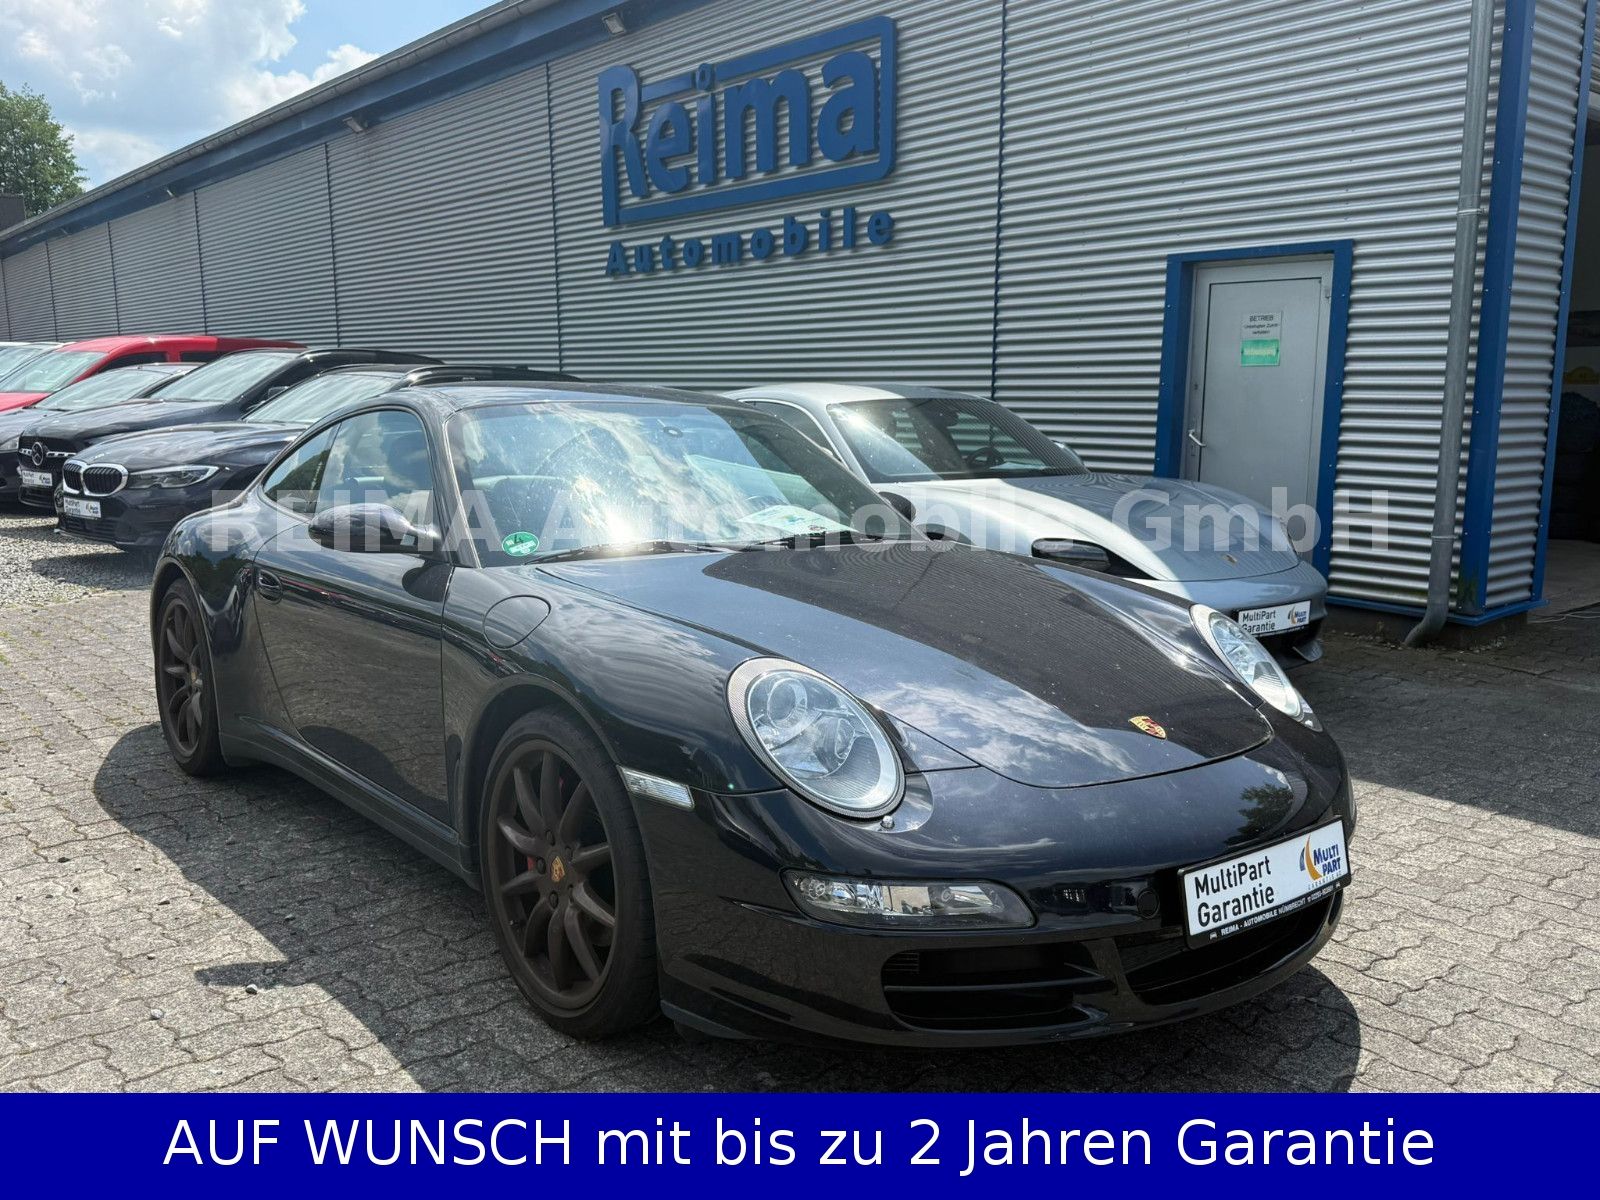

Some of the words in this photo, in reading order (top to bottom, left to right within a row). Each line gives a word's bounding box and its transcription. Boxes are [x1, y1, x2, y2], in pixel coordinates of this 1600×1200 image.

[598, 51, 879, 200] Reima
[605, 206, 896, 277] Automobile
[1242, 609, 1276, 622] MultiPart
[1242, 621, 1276, 633] Garantie
[1313, 843, 1340, 866] MULTI
[1322, 857, 1342, 877] PART
[1194, 855, 1272, 899] MultiPart
[1197, 882, 1276, 928] Garantie
[1220, 923, 1240, 937] REIMA
[1243, 908, 1278, 928] AUTOMOBILE
